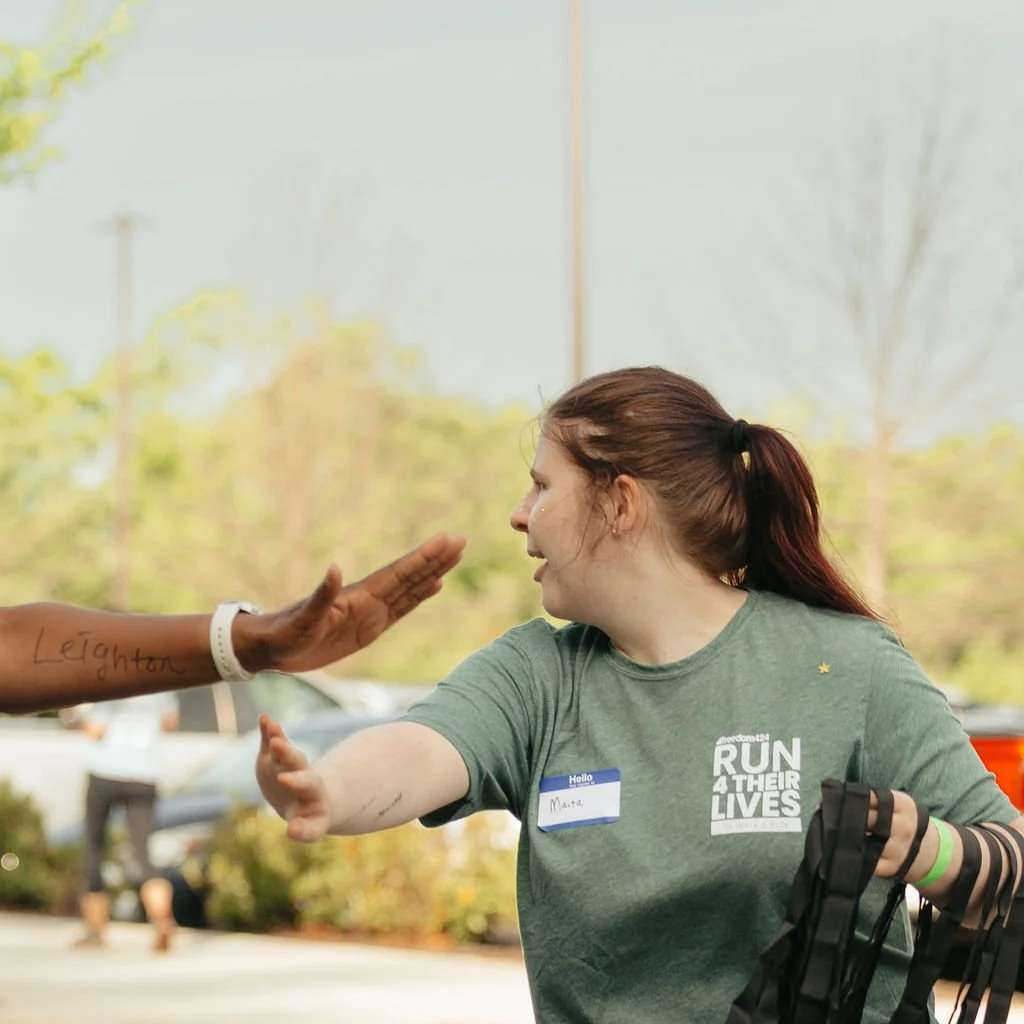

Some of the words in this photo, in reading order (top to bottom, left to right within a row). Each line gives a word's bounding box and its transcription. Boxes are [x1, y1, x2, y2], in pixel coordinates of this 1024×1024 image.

[33, 627, 186, 681] Leighton
[713, 738, 801, 776] RUN
[568, 773, 593, 785] Hello
[713, 776, 728, 794] 4
[731, 770, 801, 792] THEIR
[711, 789, 801, 820] LIVES
